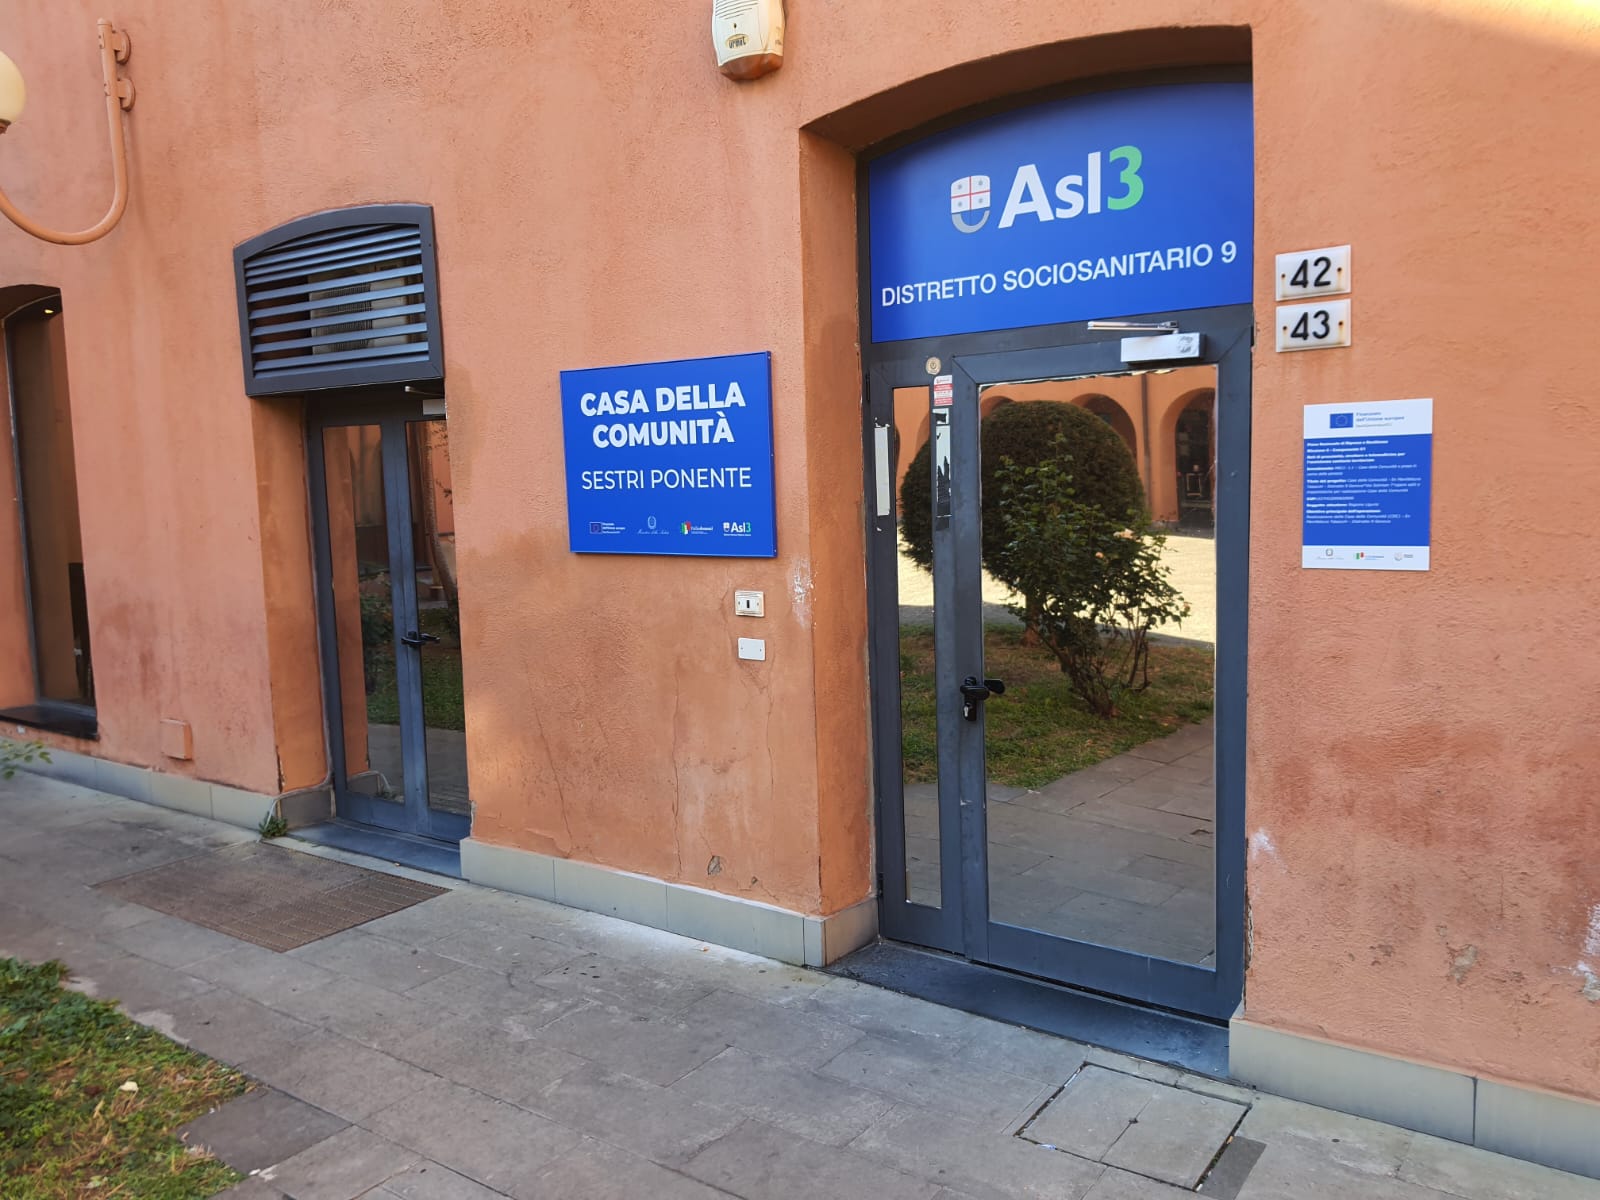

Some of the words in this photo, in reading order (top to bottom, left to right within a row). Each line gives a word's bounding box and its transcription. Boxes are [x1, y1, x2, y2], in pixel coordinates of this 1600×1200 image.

[998, 145, 1145, 229] Asl3
[881, 273, 997, 307] DISTRETTO
[1002, 242, 1213, 292] SOCIOSANITARIO
[1220, 240, 1237, 264] 9
[1290, 256, 1332, 288] 42
[1290, 310, 1331, 341] 43
[580, 389, 650, 417] CASA
[655, 381, 746, 413] DELLA
[592, 411, 735, 449] COMUNITÀ
[581, 470, 645, 490] SESTRI
[650, 467, 752, 489] PONENTE
